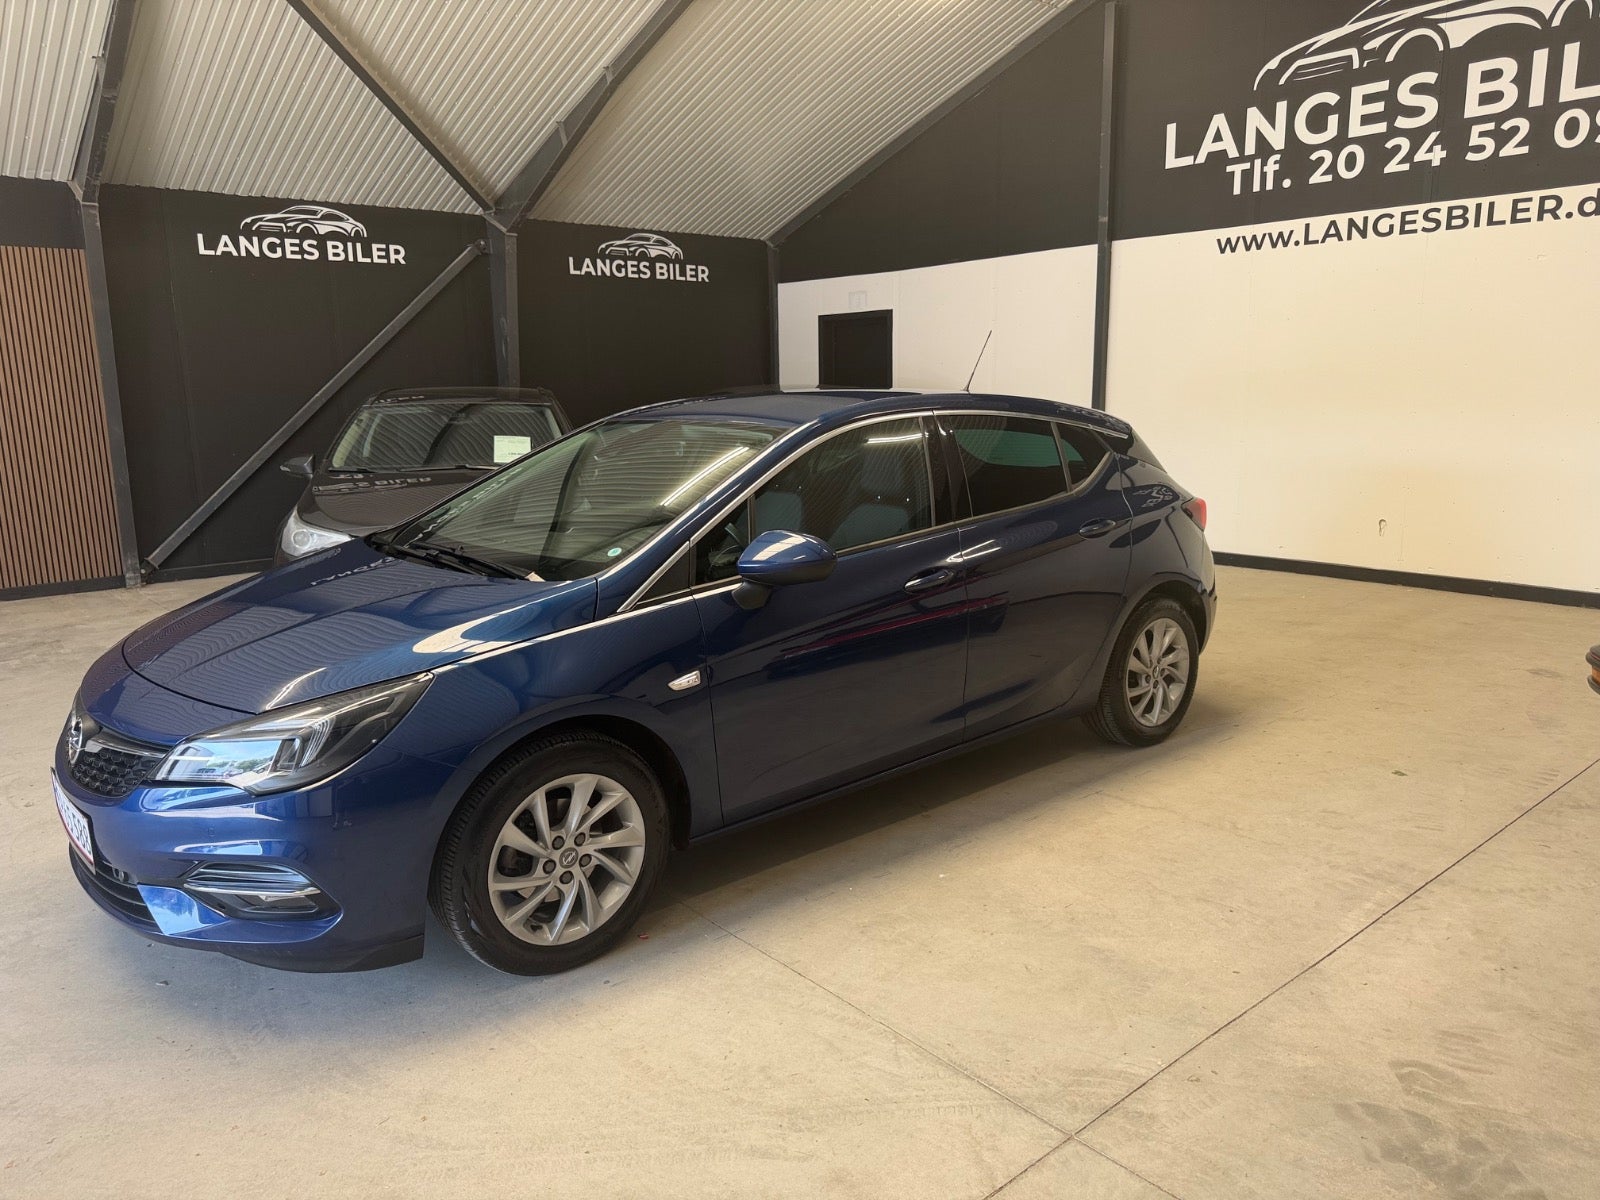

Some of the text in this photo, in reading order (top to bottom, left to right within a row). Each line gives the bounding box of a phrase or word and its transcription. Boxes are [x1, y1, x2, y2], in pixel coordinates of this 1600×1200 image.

[1164, 41, 1600, 170] LANGES BIL
[1225, 108, 1600, 196] Tlf. 20 24 52 0
[196, 232, 406, 265] LANGES BILER
[1216, 188, 1600, 255] www.LANGESBILER.d
[568, 256, 709, 282] LANGES BILER
